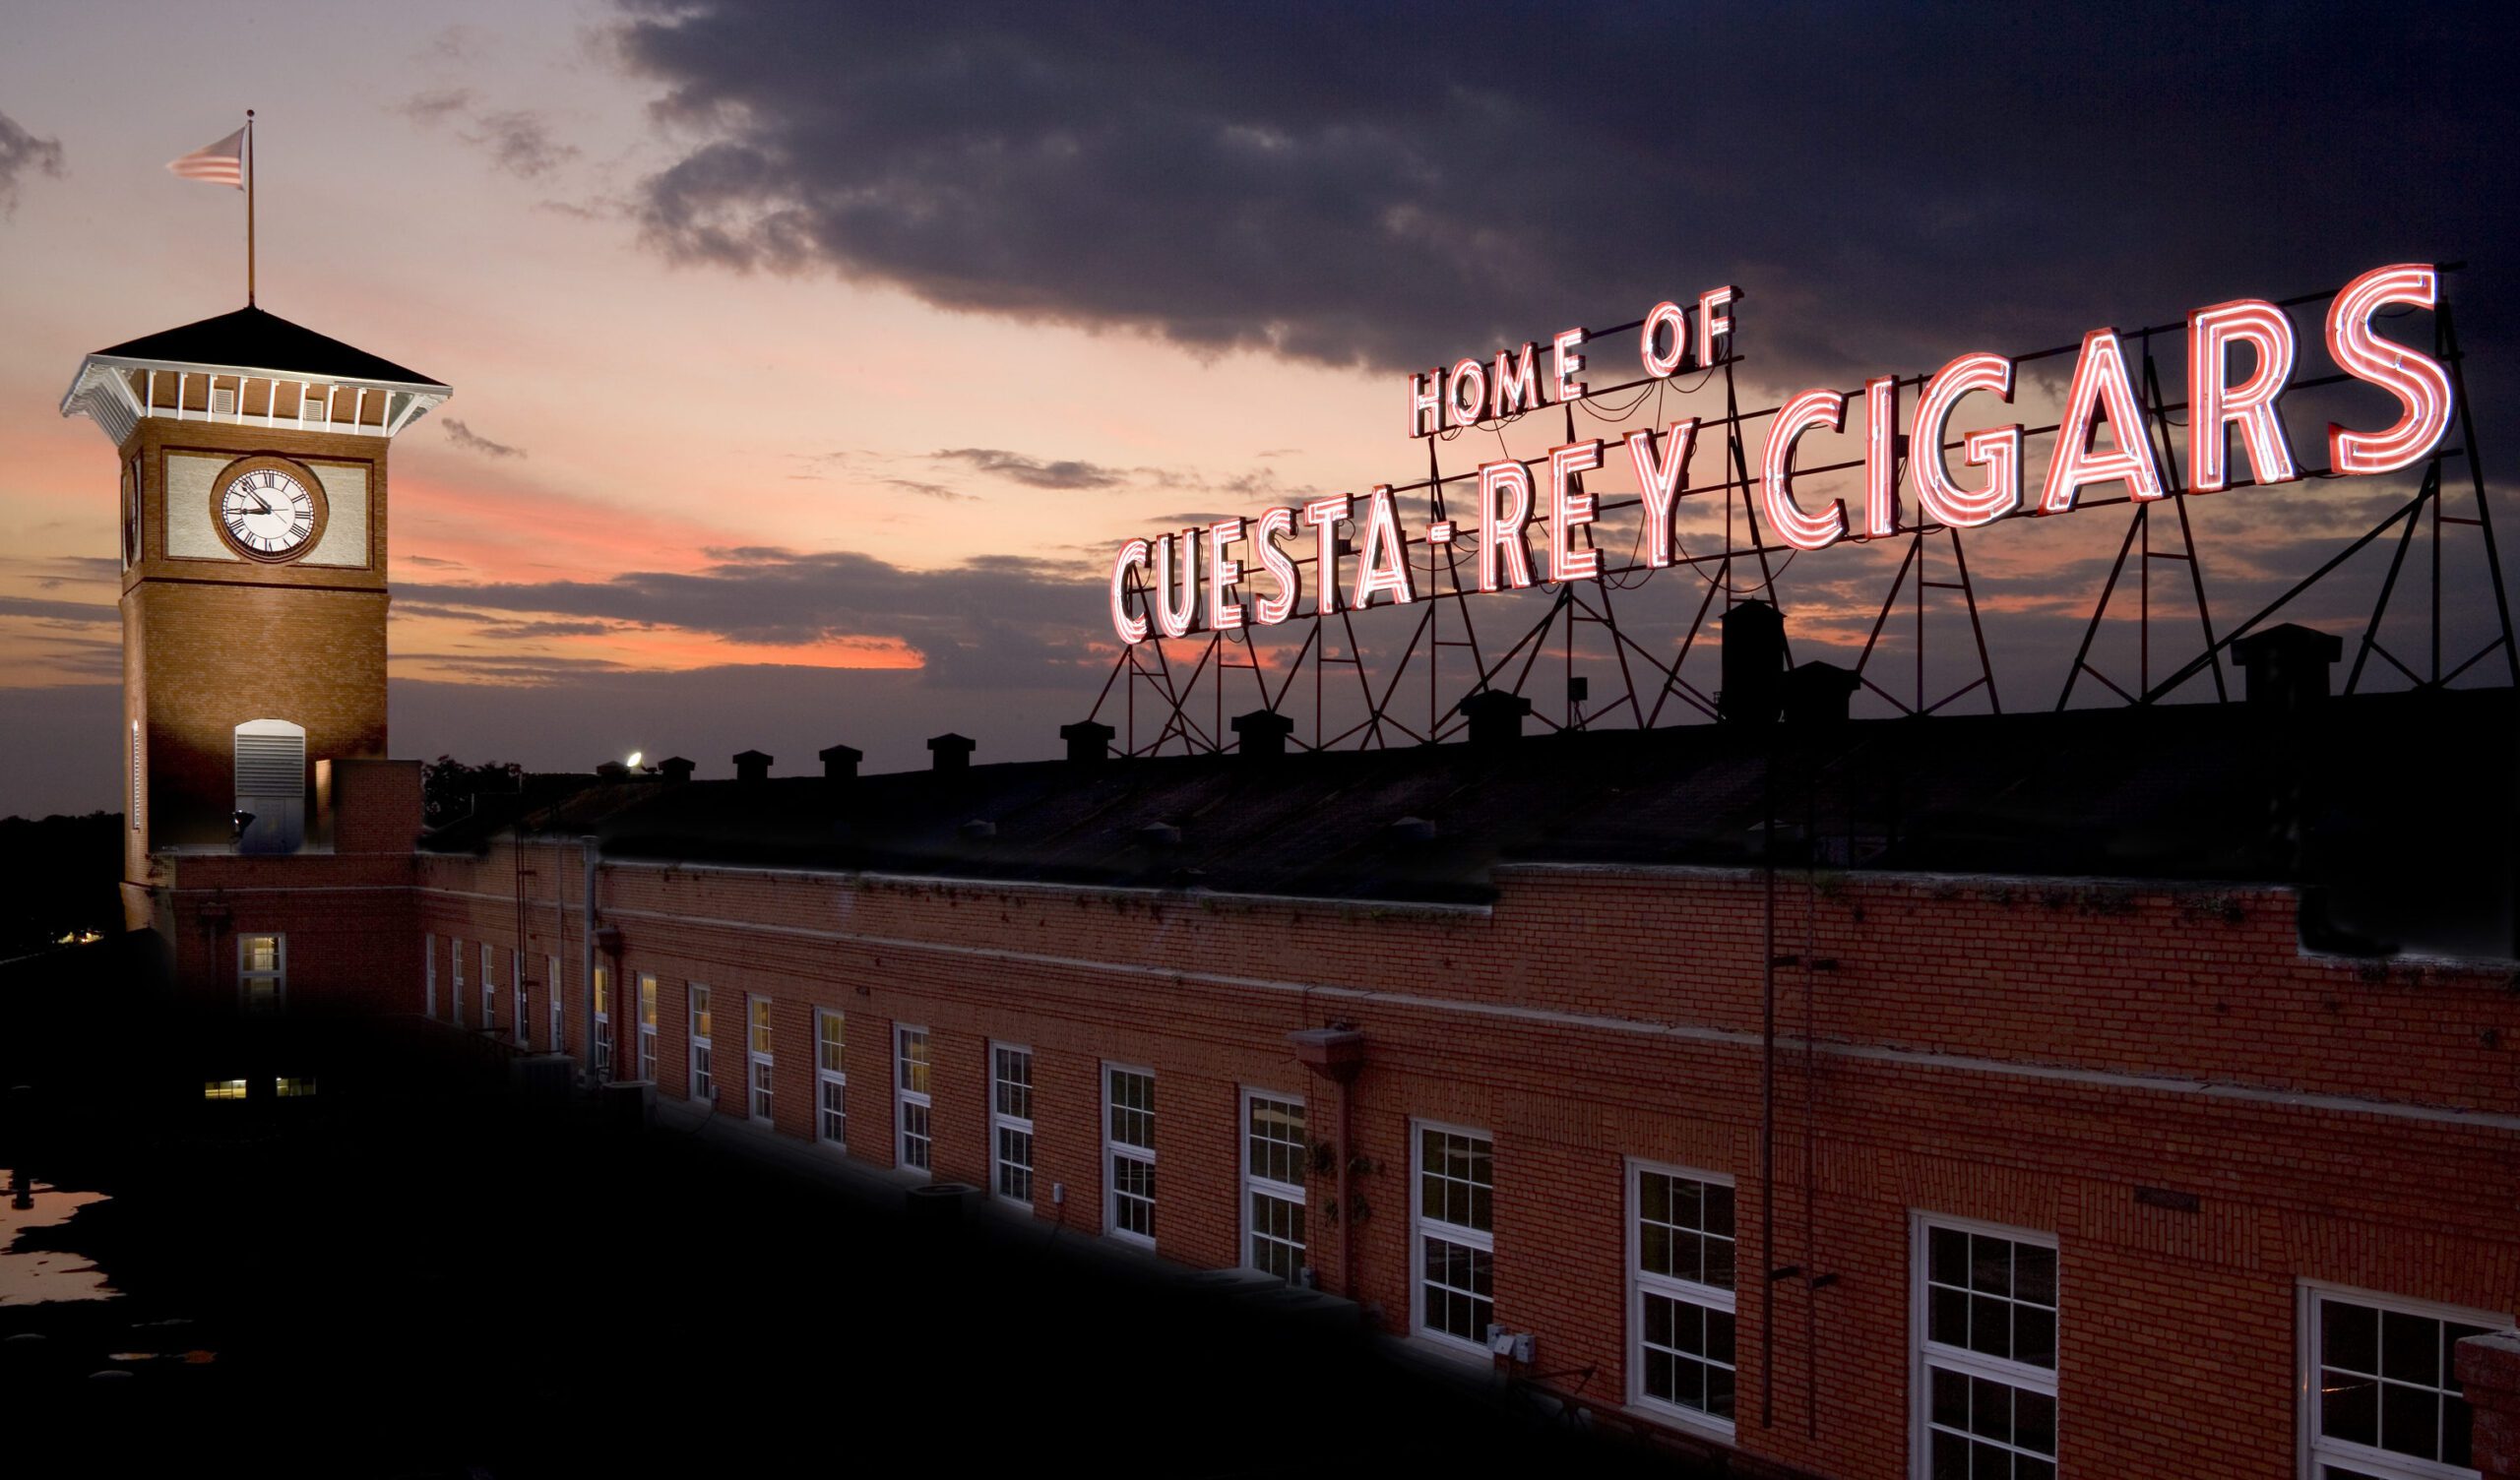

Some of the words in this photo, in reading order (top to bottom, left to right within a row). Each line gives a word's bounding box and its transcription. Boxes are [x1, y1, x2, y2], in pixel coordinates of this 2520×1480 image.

[1409, 327, 1587, 438] HOME
[1640, 285, 1739, 378] OF
[1759, 263, 2453, 551] CIGARS
